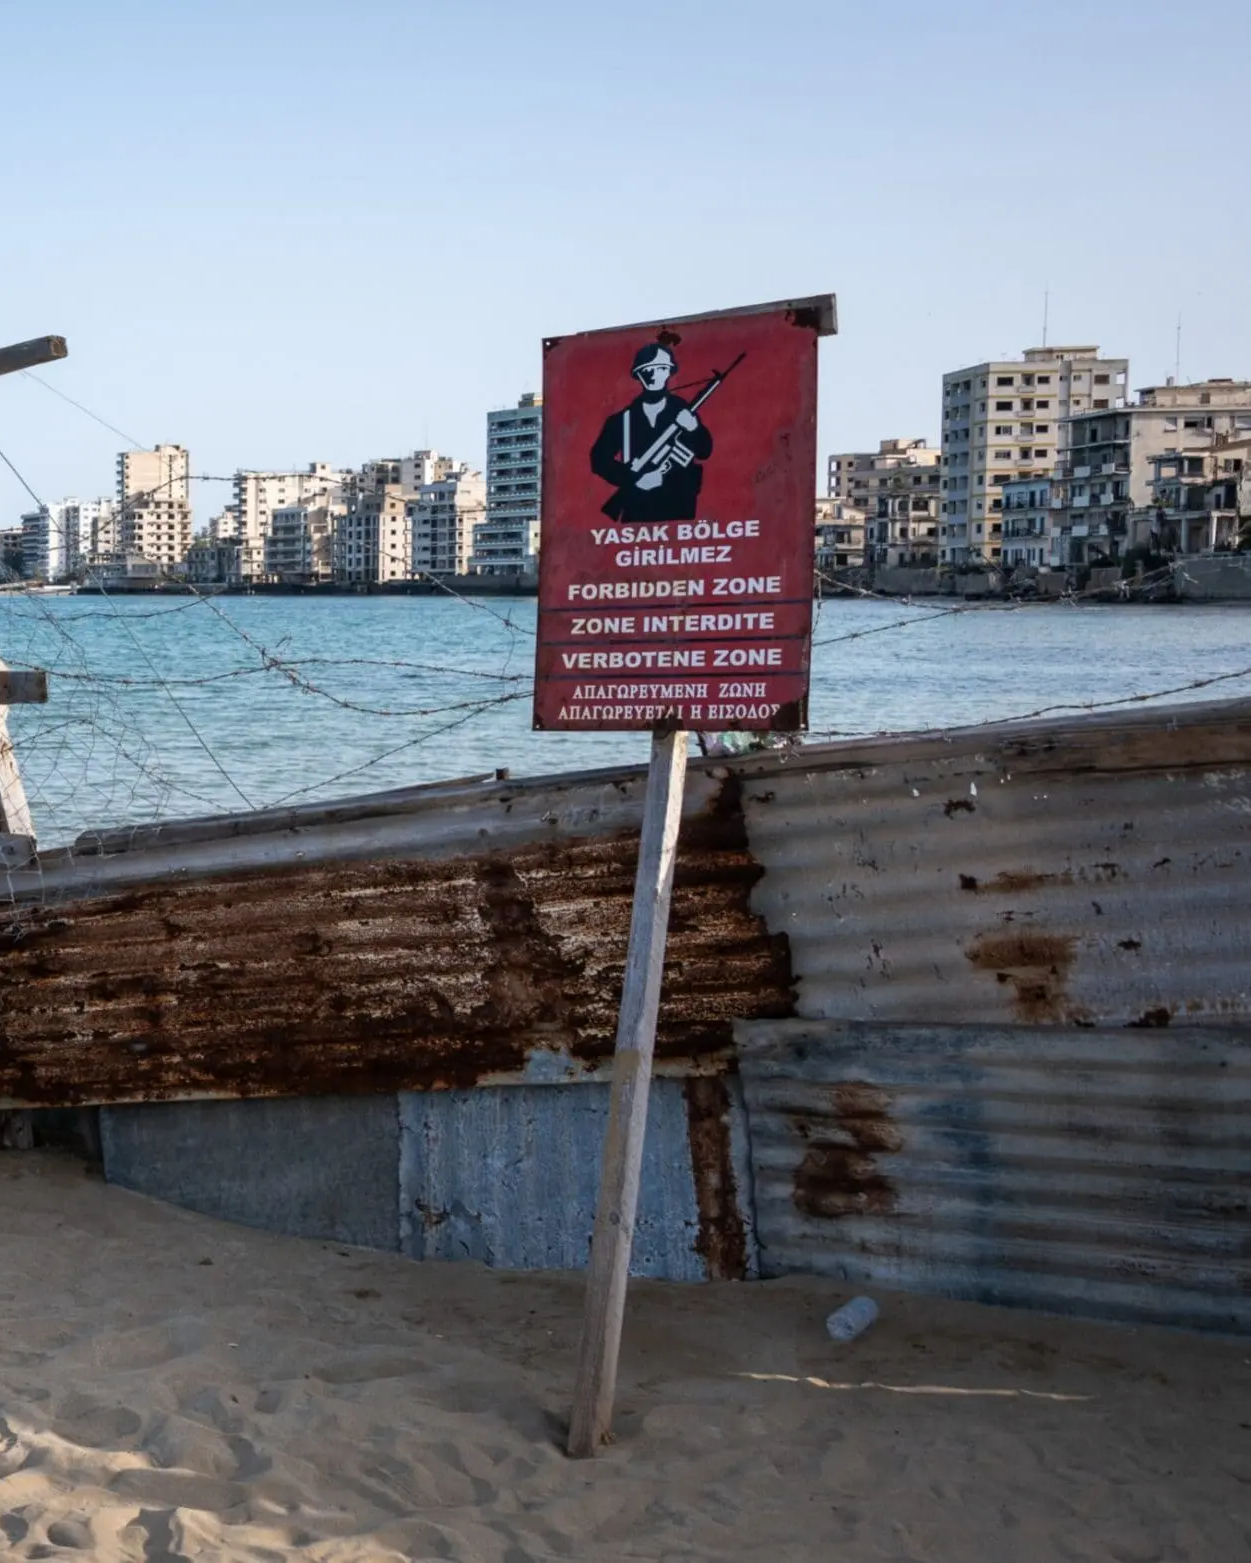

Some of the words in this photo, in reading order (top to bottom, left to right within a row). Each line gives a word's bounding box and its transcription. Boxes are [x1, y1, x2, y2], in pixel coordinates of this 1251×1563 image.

[591, 524, 669, 545] YASAK
[677, 520, 760, 541] BÖLGE
[615, 545, 732, 567] GİRİLMEZ
[568, 579, 704, 600] FORBIDDEN
[712, 576, 781, 596] ZONE
[570, 617, 635, 635] ZONE
[643, 612, 775, 633] INTERDITE
[561, 650, 705, 669] VERBOTENE
[713, 648, 782, 667] ZONE
[572, 683, 708, 699] ΑΠΑΓΩΡΕΥΜΕΝΗ
[718, 682, 767, 698] ΖΩΝΗ
[558, 704, 683, 720] ΑΠΑΓΩΡΕΥΕΤΑΙ
[690, 705, 702, 720] Η
